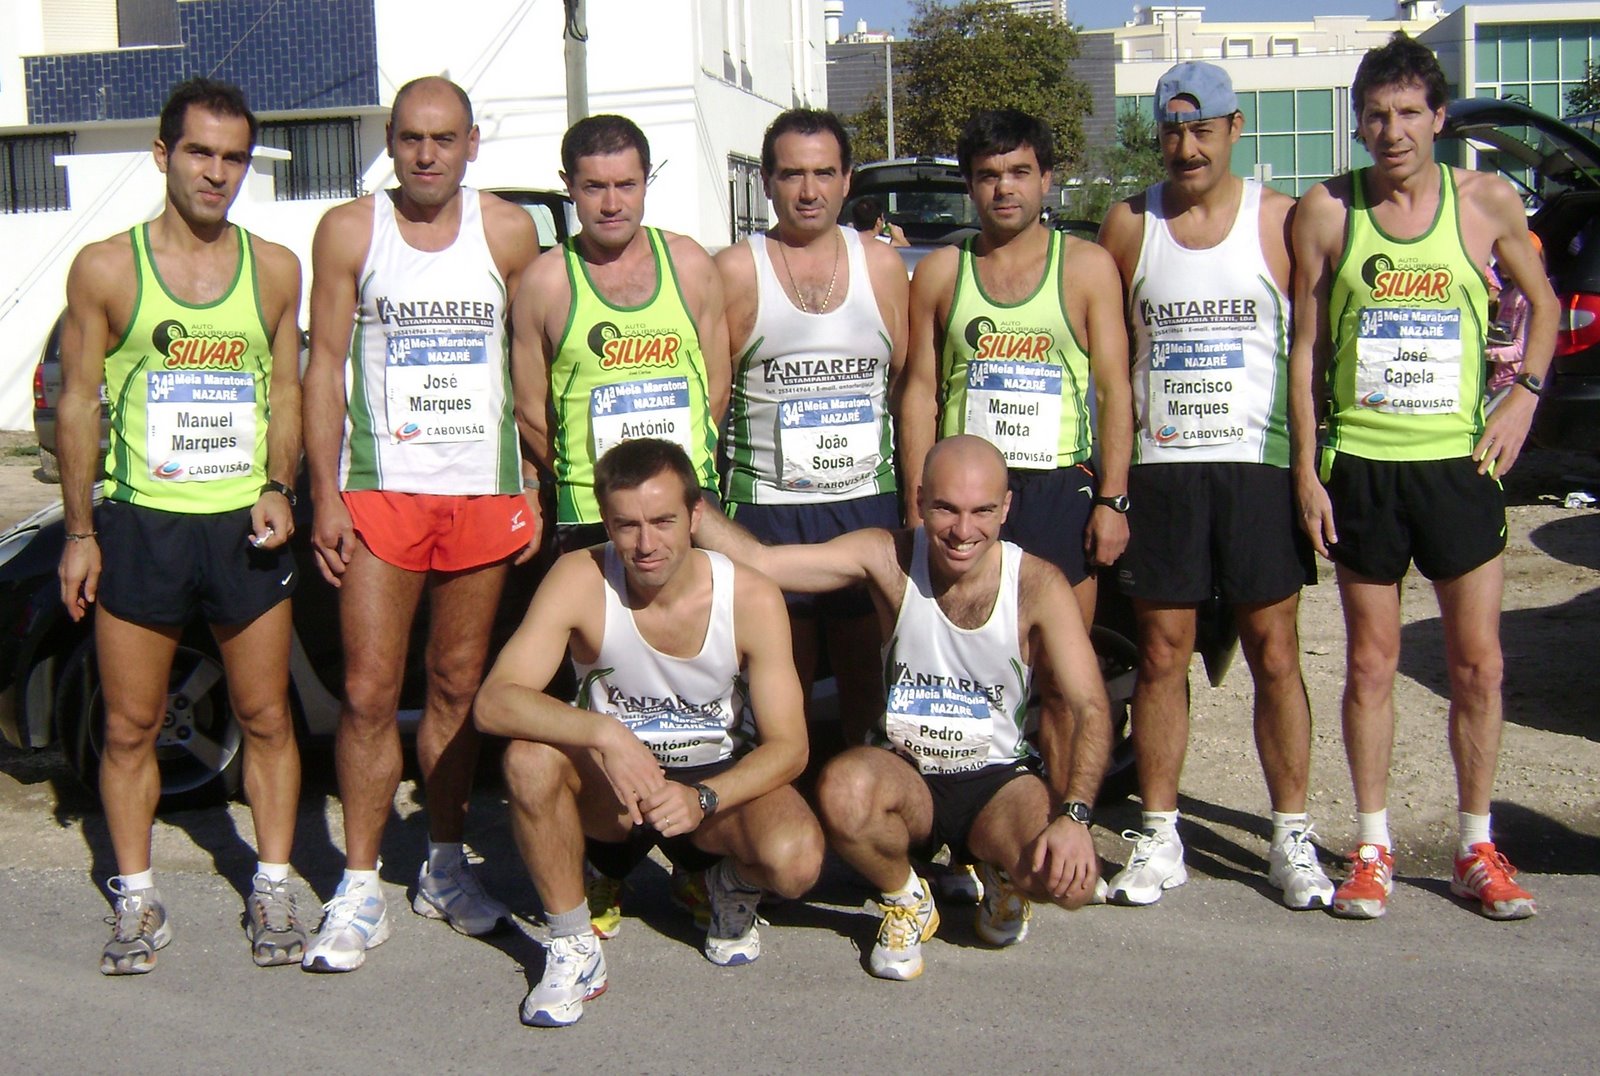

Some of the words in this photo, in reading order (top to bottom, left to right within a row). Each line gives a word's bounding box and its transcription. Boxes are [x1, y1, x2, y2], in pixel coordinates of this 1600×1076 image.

[1374, 271, 1449, 299] SILVAR
[376, 297, 494, 325] ANTARFER
[1140, 299, 1256, 326] ANTARFER
[1384, 310, 1408, 321] Meia
[1412, 311, 1458, 322] Maratona
[1160, 317, 1208, 326] ESTAMPARIA
[1400, 324, 1444, 337] NAZARÉ
[410, 338, 436, 349] Meia
[438, 337, 484, 348] Maratona
[976, 335, 1051, 362] SILVAR
[1171, 343, 1192, 354] Meia
[1195, 342, 1242, 353] Maratona
[167, 338, 245, 367] SILVAR
[428, 351, 470, 362] NAZARÉ
[603, 337, 678, 367] SILVAR
[1393, 347, 1428, 362] José
[1185, 355, 1228, 367] NAZARÉ
[762, 358, 879, 383] ANTARFER
[989, 364, 1014, 374] Meia
[1016, 366, 1061, 378] Maratona
[1384, 368, 1434, 386] Capela
[175, 374, 200, 385] Meia
[204, 376, 254, 386] Maratona
[424, 373, 458, 389] José
[784, 376, 836, 384] ESTAMPARIA
[1004, 378, 1046, 391] NAZARÉ
[1164, 378, 1233, 394] Francisco
[192, 389, 238, 400] NAZARÉ
[616, 384, 641, 396] Meia
[644, 381, 688, 394] Maratona
[410, 396, 472, 414] Marques
[634, 394, 676, 409] NAZARÉ
[804, 400, 828, 412] Meia
[830, 398, 871, 409] Maratona
[989, 399, 1039, 416] Manuel
[1168, 400, 1229, 418] Marques
[1392, 397, 1454, 408] CABOVISÃO
[177, 412, 233, 428] Manuel
[821, 409, 860, 424] NAZARÉ
[427, 424, 485, 436] CABOVISÃO
[621, 418, 675, 438] António
[996, 420, 1030, 437] Mota
[1183, 427, 1244, 440] CABOVISÃO
[172, 435, 237, 453] Marques
[816, 434, 848, 449] João
[813, 456, 854, 470] Sousa
[1004, 452, 1052, 463] ABOVISÃO
[188, 461, 250, 476] CABOVISÃO
[817, 471, 871, 489] CABOVISÃO
[916, 689, 940, 699] Meia
[943, 689, 985, 705] Maratona
[920, 725, 963, 742] Pedro
[904, 739, 977, 759] Regueiras
